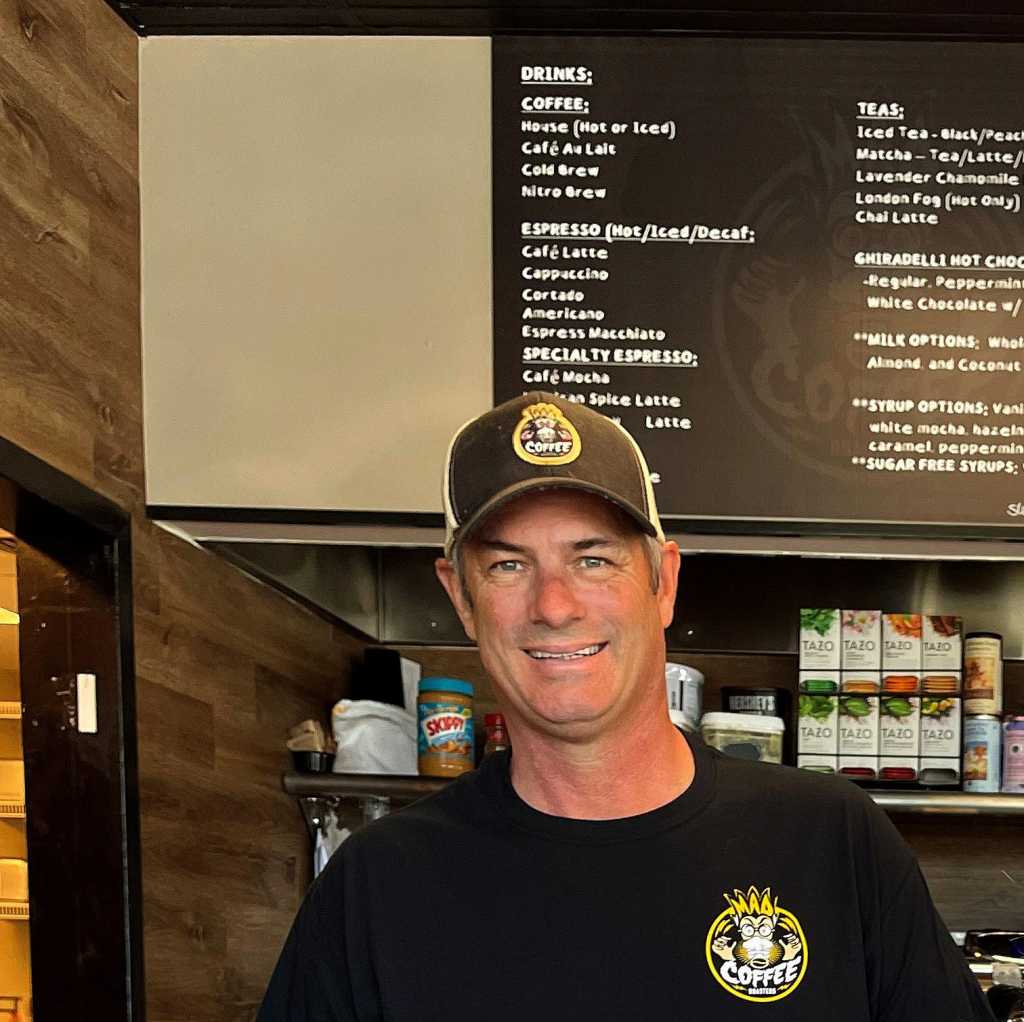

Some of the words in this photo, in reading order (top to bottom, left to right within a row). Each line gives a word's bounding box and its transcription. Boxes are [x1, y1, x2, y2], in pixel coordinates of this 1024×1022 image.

[521, 66, 592, 83] DRINKS:
[521, 96, 589, 112] COFFEE:
[856, 101, 904, 118] TEAS:
[521, 120, 568, 133] House
[574, 119, 607, 139] (Hot
[611, 122, 628, 133] or
[634, 120, 675, 139] Iced)
[857, 125, 894, 139] Iced
[899, 126, 928, 139] Tea
[522, 141, 559, 155] Café
[562, 142, 582, 155] Au
[585, 142, 616, 155] Lait
[856, 148, 912, 161] Matcha
[521, 163, 554, 176] Cold
[558, 164, 599, 177] Brew
[856, 170, 931, 183] Lavender
[936, 172, 1019, 185] Chamomile
[522, 184, 561, 198] Nitro
[565, 186, 606, 198] Brew
[856, 191, 909, 204] London
[913, 193, 941, 208] Fog
[945, 192, 977, 211] (Hot
[981, 193, 1020, 212] Only)
[856, 210, 888, 223] Chai
[893, 211, 938, 224] Latte
[521, 222, 601, 236] ESPRESSO
[522, 244, 559, 259] Café
[563, 246, 608, 259] Latte
[855, 251, 946, 267] GHIRADELLI
[951, 254, 981, 266] HOT
[522, 266, 608, 280] Cappuccino
[522, 289, 584, 301] Cortado
[522, 307, 604, 320] Americano
[868, 296, 913, 310] White
[918, 297, 996, 311] Chocolate
[1002, 298, 1021, 317] w/
[522, 325, 585, 339] Espress
[589, 327, 665, 340] Macchiato
[909, 334, 979, 349] OPTIONS:
[523, 347, 610, 361] SPECIALTY
[611, 350, 698, 366] ESPRESSO:
[929, 358, 954, 369] and
[958, 358, 1020, 371] Coconut
[523, 369, 559, 384] Café
[563, 371, 610, 384] Mocha
[590, 392, 631, 406] Spice
[636, 394, 680, 407] Latte
[918, 400, 988, 415] OPTIONS:
[646, 415, 691, 429] Latte
[870, 421, 912, 434] white
[524, 441, 572, 453] COFFEE
[919, 458, 955, 471] FREE
[959, 459, 1018, 474] SYRUPS:
[802, 641, 834, 651] TAZO
[843, 641, 875, 651] TAZO
[885, 641, 912, 650] TAZO
[924, 642, 952, 651] TAZO
[801, 728, 832, 738] TAZO
[840, 728, 872, 739] TAZO
[881, 728, 913, 739] TAZO
[922, 729, 954, 740] TAZO
[720, 956, 802, 988] COFFEE
